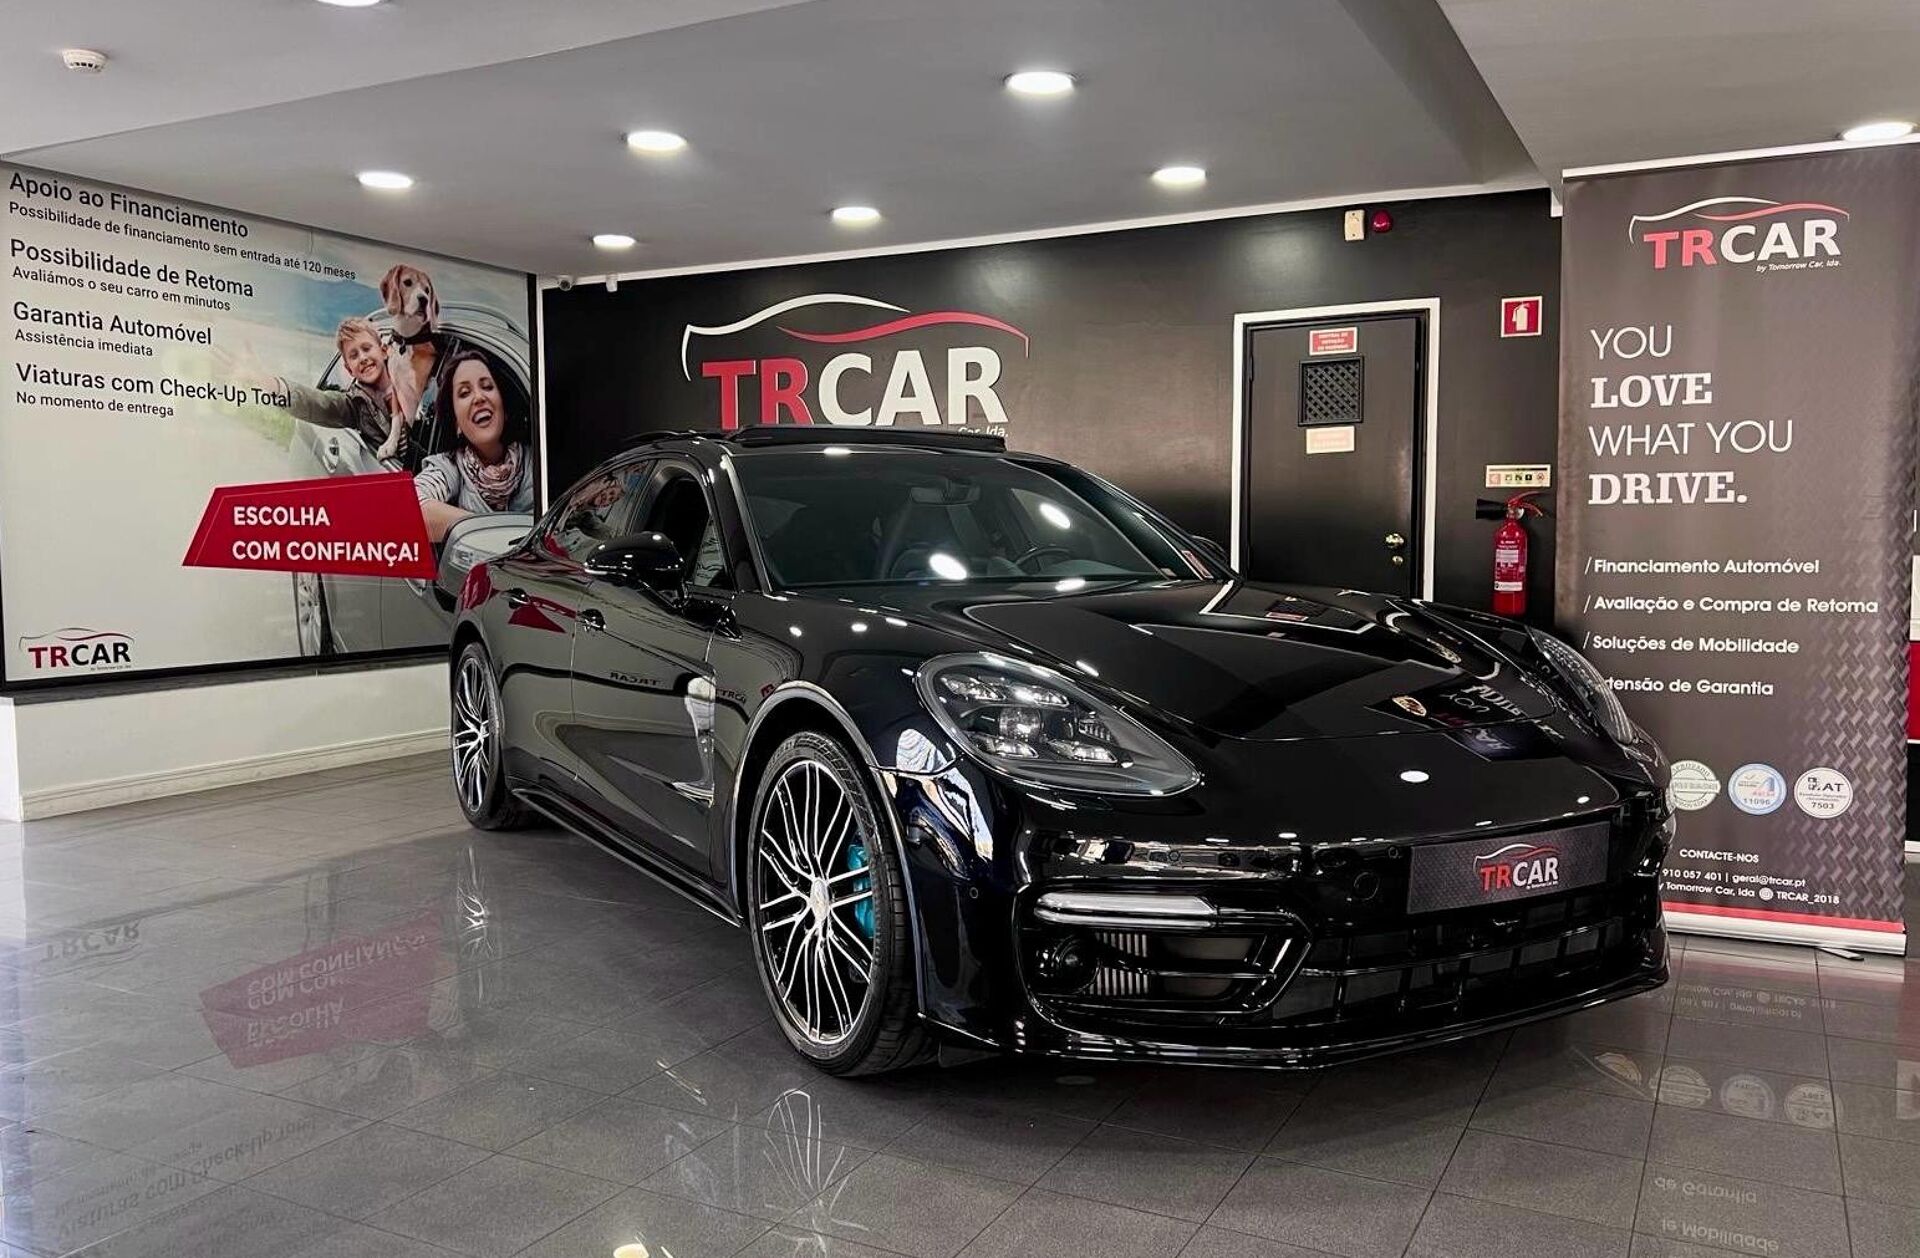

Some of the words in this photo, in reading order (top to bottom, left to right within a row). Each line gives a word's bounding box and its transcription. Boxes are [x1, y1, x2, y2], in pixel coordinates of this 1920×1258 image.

[10, 172, 72, 201] Apoio
[79, 187, 104, 207] ao
[110, 192, 249, 238] Financiamento
[10, 202, 101, 230] Possibilidade
[105, 217, 120, 233] de
[124, 223, 209, 252] financiamento
[214, 243, 237, 256] sem
[240, 246, 280, 266] entrada
[284, 255, 300, 269] até
[303, 259, 321, 273] 120
[324, 266, 356, 280] meses
[1643, 219, 1841, 269] TRCAR
[11, 240, 150, 279] Possibilidade
[157, 264, 180, 283] de
[185, 270, 254, 297] Retoma
[1768, 262, 1806, 271] Tomorrow
[13, 266, 84, 289] Avaliámos
[88, 280, 97, 290] o
[100, 282, 122, 294] seu
[126, 286, 157, 299] carro
[162, 291, 180, 303] em
[184, 291, 230, 311] minutos
[14, 302, 103, 331] Garantia
[110, 316, 212, 346] Automóvel
[15, 330, 93, 350] Assistência
[98, 338, 153, 357] imediata
[1591, 325, 1672, 360] YOU
[16, 363, 104, 388] Viaturas
[111, 376, 153, 395] com
[160, 379, 247, 407] Check-Up
[251, 387, 291, 408] Total
[702, 347, 1008, 430] TRCAR
[1591, 373, 1712, 408] LOVE
[17, 392, 36, 404] No
[40, 395, 103, 410] momento
[109, 398, 124, 412] de
[127, 403, 174, 417] entrega
[1589, 423, 1695, 456] WHAT
[1706, 420, 1792, 453] YOU
[1589, 471, 1748, 505] DRIVE.
[234, 506, 330, 526] ESCOLHA
[232, 540, 280, 561] COM
[286, 542, 419, 567] CONFIANÇA!
[1724, 559, 1819, 574] Automóvel
[1683, 600, 1694, 610] e
[1700, 598, 1771, 615] Compra
[1778, 599, 1801, 613] de
[1807, 598, 1878, 613] Retoma
[28, 642, 130, 668] TRCAR
[1671, 638, 1694, 650] de
[1699, 638, 1799, 653] Mobilidade
[1669, 679, 1691, 692] de
[1696, 680, 1773, 696] Garantia
[1680, 849, 1759, 863] CONTACTE-NOS
[1481, 857, 1558, 891] TRCAR
[1662, 869, 1681, 877] 910
[1683, 870, 1701, 879] 057
[1705, 872, 1721, 881] 401
[1732, 874, 1806, 887] geral@trcar.pt
[1666, 882, 1712, 893] Tomorrow
[1777, 891, 1839, 904] TRCAR_2018
